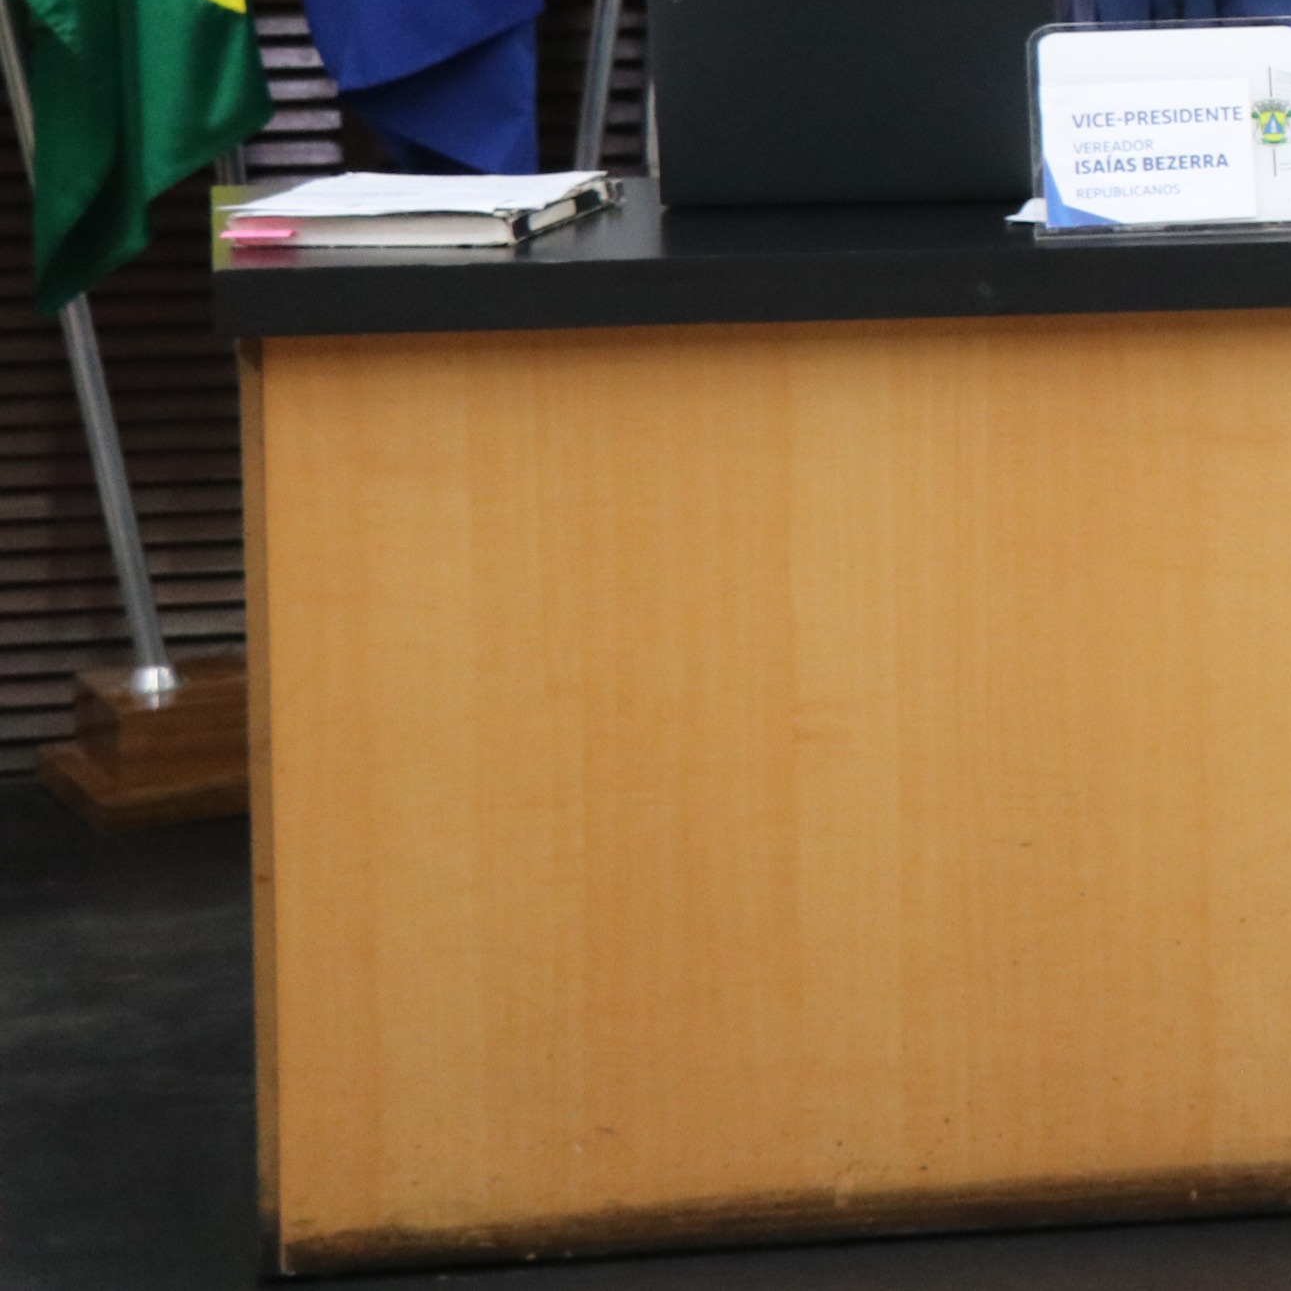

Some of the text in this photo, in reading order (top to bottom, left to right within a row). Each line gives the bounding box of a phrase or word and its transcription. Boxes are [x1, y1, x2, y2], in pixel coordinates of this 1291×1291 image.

[1072, 106, 1243, 129] VICE-PRESIDENTE
[1073, 139, 1154, 155] VEREADOR
[1074, 153, 1229, 175] ISAÍAS BEZERRA
[1076, 183, 1181, 200] REPUBLICANOS
